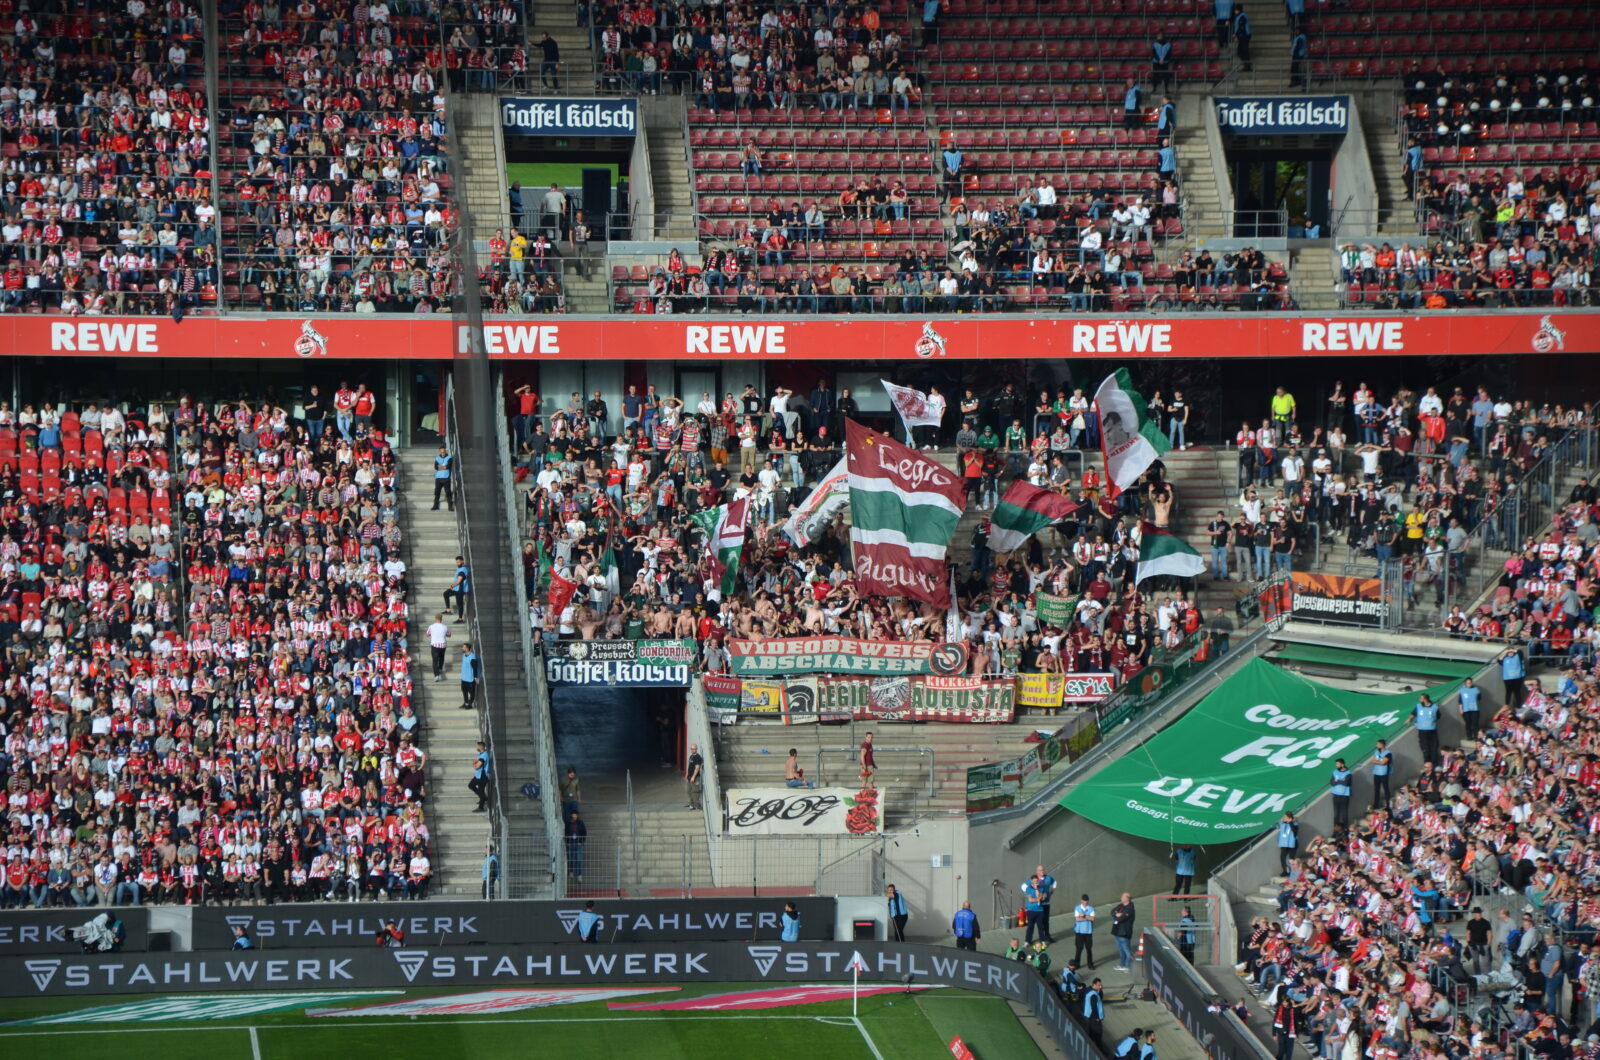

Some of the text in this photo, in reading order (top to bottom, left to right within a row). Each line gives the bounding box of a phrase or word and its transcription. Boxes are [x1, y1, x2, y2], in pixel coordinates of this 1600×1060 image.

[502, 103, 635, 131] Gaffel Kölsch
[1216, 100, 1346, 128] Gaffel Kölsch
[51, 322, 159, 353] REWE
[458, 325, 560, 354] REWE
[685, 326, 786, 354] REWE
[1072, 324, 1172, 353] REWE
[1303, 322, 1404, 351] REWE
[878, 444, 951, 489] Legio
[639, 646, 692, 657] CONCORDIA
[736, 640, 931, 658] VIDEOBEWEIS
[741, 655, 924, 671] ABSCHAFFEN
[925, 675, 982, 688] KICKERS
[818, 685, 870, 708] LEGIO
[912, 686, 1012, 710] AUGUSTA
[1244, 704, 1348, 731] Come
[1220, 734, 1360, 769] FC!
[1143, 776, 1302, 814] DEVK
[729, 795, 840, 828] 1907
[1126, 799, 1169, 820] Gesagt.
[1173, 815, 1209, 828] Getan.
[597, 912, 779, 930] TAHLWER
[65, 958, 354, 987] STAHLWERK
[431, 952, 709, 979] STAHLWERK
[785, 952, 1021, 994] STAHLWERK
